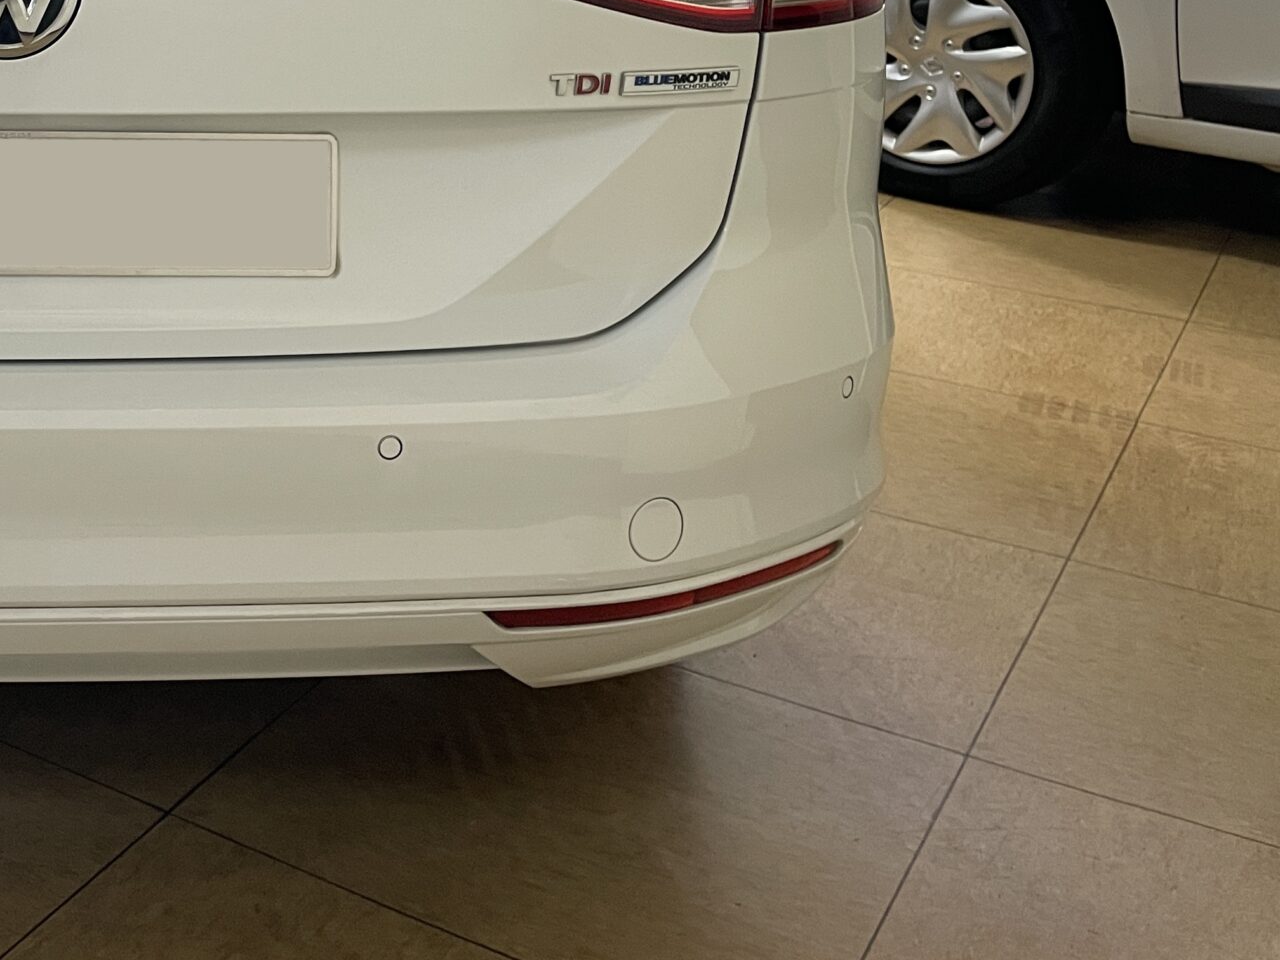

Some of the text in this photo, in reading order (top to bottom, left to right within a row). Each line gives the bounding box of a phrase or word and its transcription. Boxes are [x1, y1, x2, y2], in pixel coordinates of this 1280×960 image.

[550, 71, 731, 96] TDI BLUEMOTION
[673, 82, 729, 90] TECHNOLOGY
